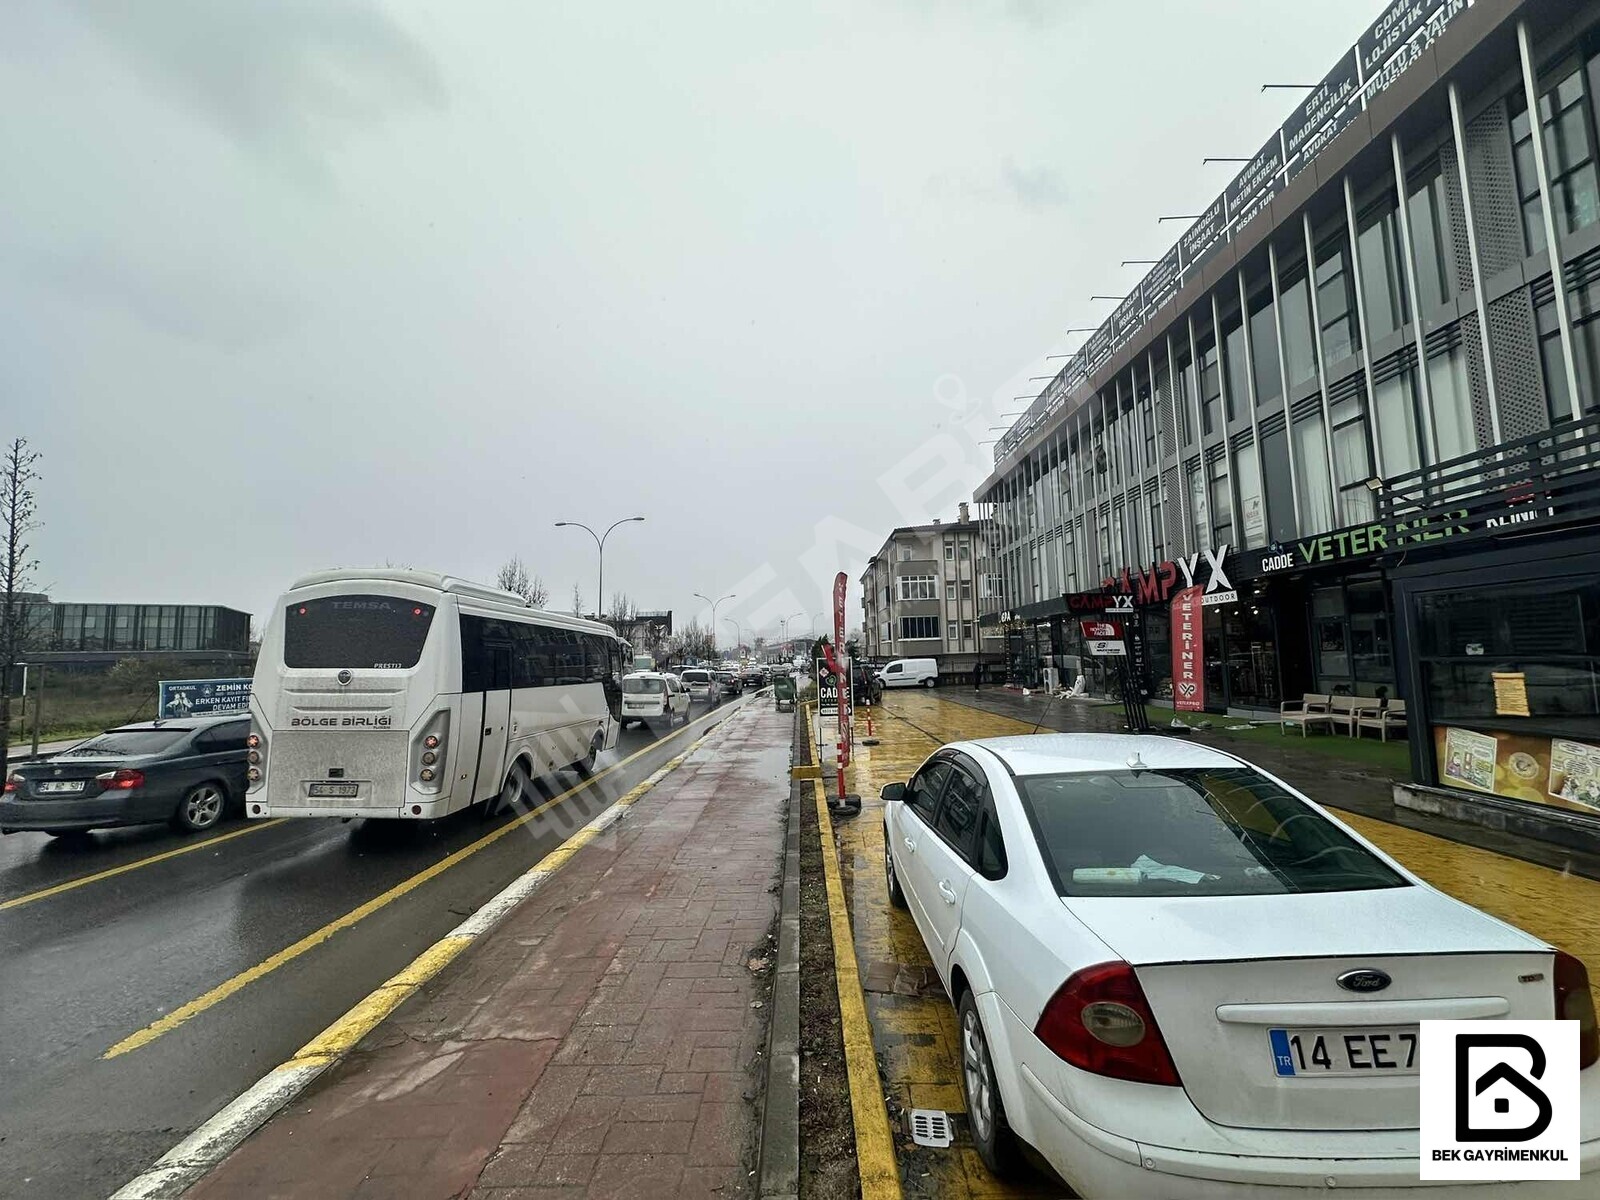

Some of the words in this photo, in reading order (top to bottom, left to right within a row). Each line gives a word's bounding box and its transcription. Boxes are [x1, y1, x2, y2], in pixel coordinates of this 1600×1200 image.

[1365, 1, 1422, 70] LOJİSTİK
[1366, 51, 1407, 99] MUTLU
[1410, 40, 1420, 56] &
[1289, 77, 1352, 151] MADENCİLİK
[1305, 81, 1329, 116] ERTİ
[1303, 120, 1338, 161] AVUKAT
[1230, 184, 1251, 212] METİN
[1252, 155, 1278, 188] EKREM
[1238, 153, 1265, 189] AVUKAT
[1236, 207, 1258, 233] NİSAN
[1259, 190, 1275, 210] TUR
[1262, 553, 1294, 572] CADDE
[333, 601, 391, 609] TEMSA
[1202, 593, 1236, 605] OUTDOOR
[1182, 594, 1193, 679] VETERİNER
[216, 682, 241, 692] ZEMİN
[213, 703, 236, 711] DEVAM
[291, 716, 338, 726] BÖLGE
[342, 715, 391, 726] BİRLİĞİ
[1352, 976, 1380, 988] Ford
[1278, 1055, 1291, 1067] TR
[1290, 1035, 1332, 1070] 14
